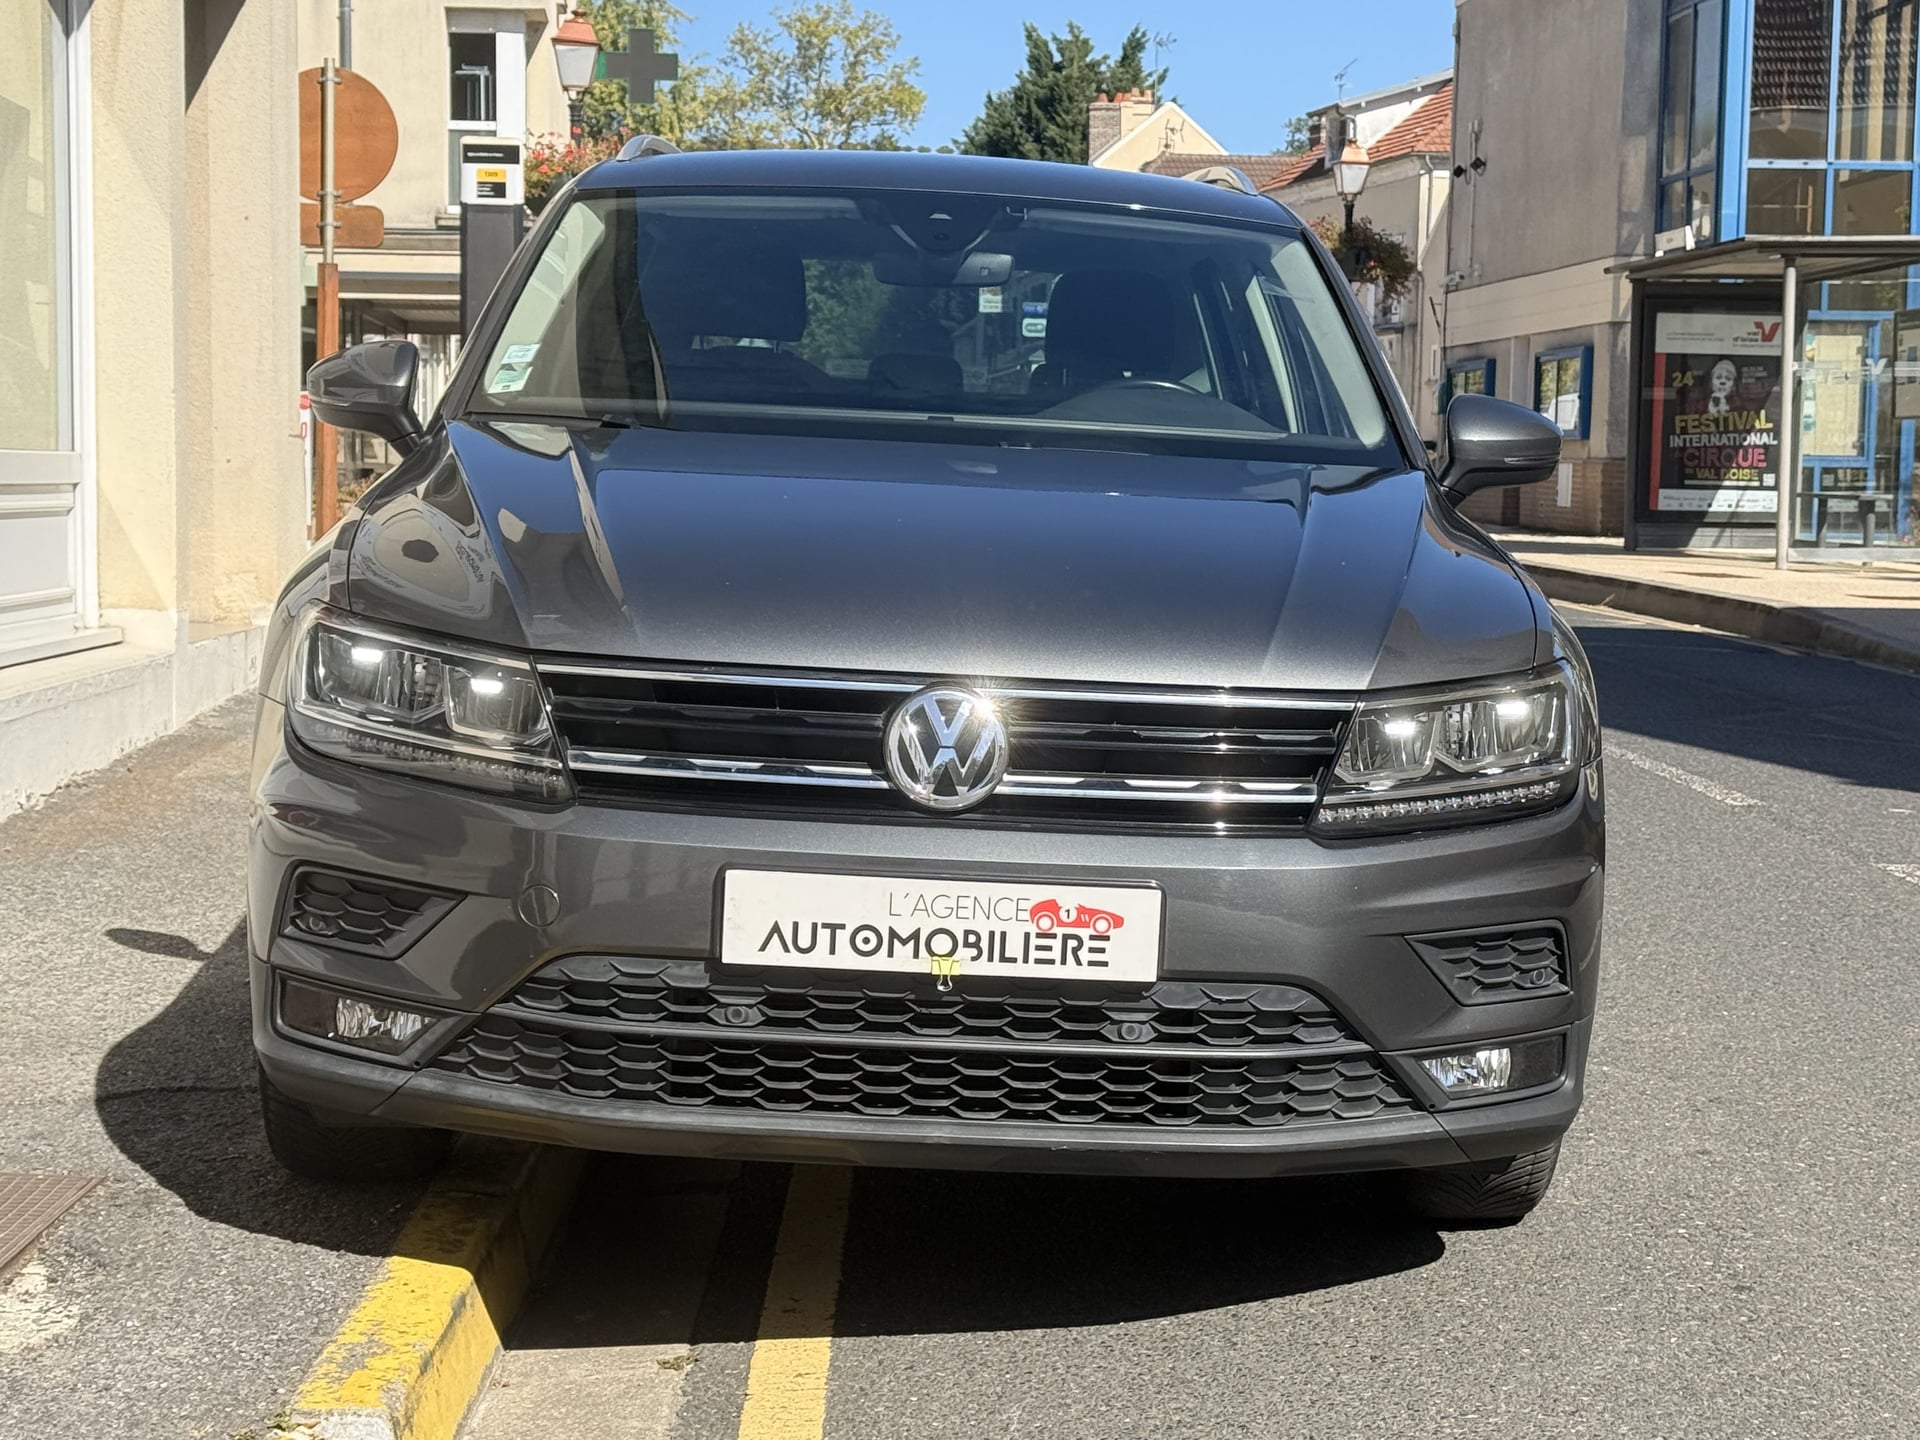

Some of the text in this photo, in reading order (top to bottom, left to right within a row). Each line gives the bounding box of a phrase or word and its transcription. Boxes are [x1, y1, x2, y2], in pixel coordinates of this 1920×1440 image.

[1671, 370, 1695, 388] 24
[1674, 409, 1774, 434] FESTIVAL
[1669, 431, 1778, 448] INTERNATIONAL
[1683, 447, 1767, 468] CIRQUE
[1695, 467, 1718, 479] VAL
[889, 892, 1031, 922] L'AGENCE
